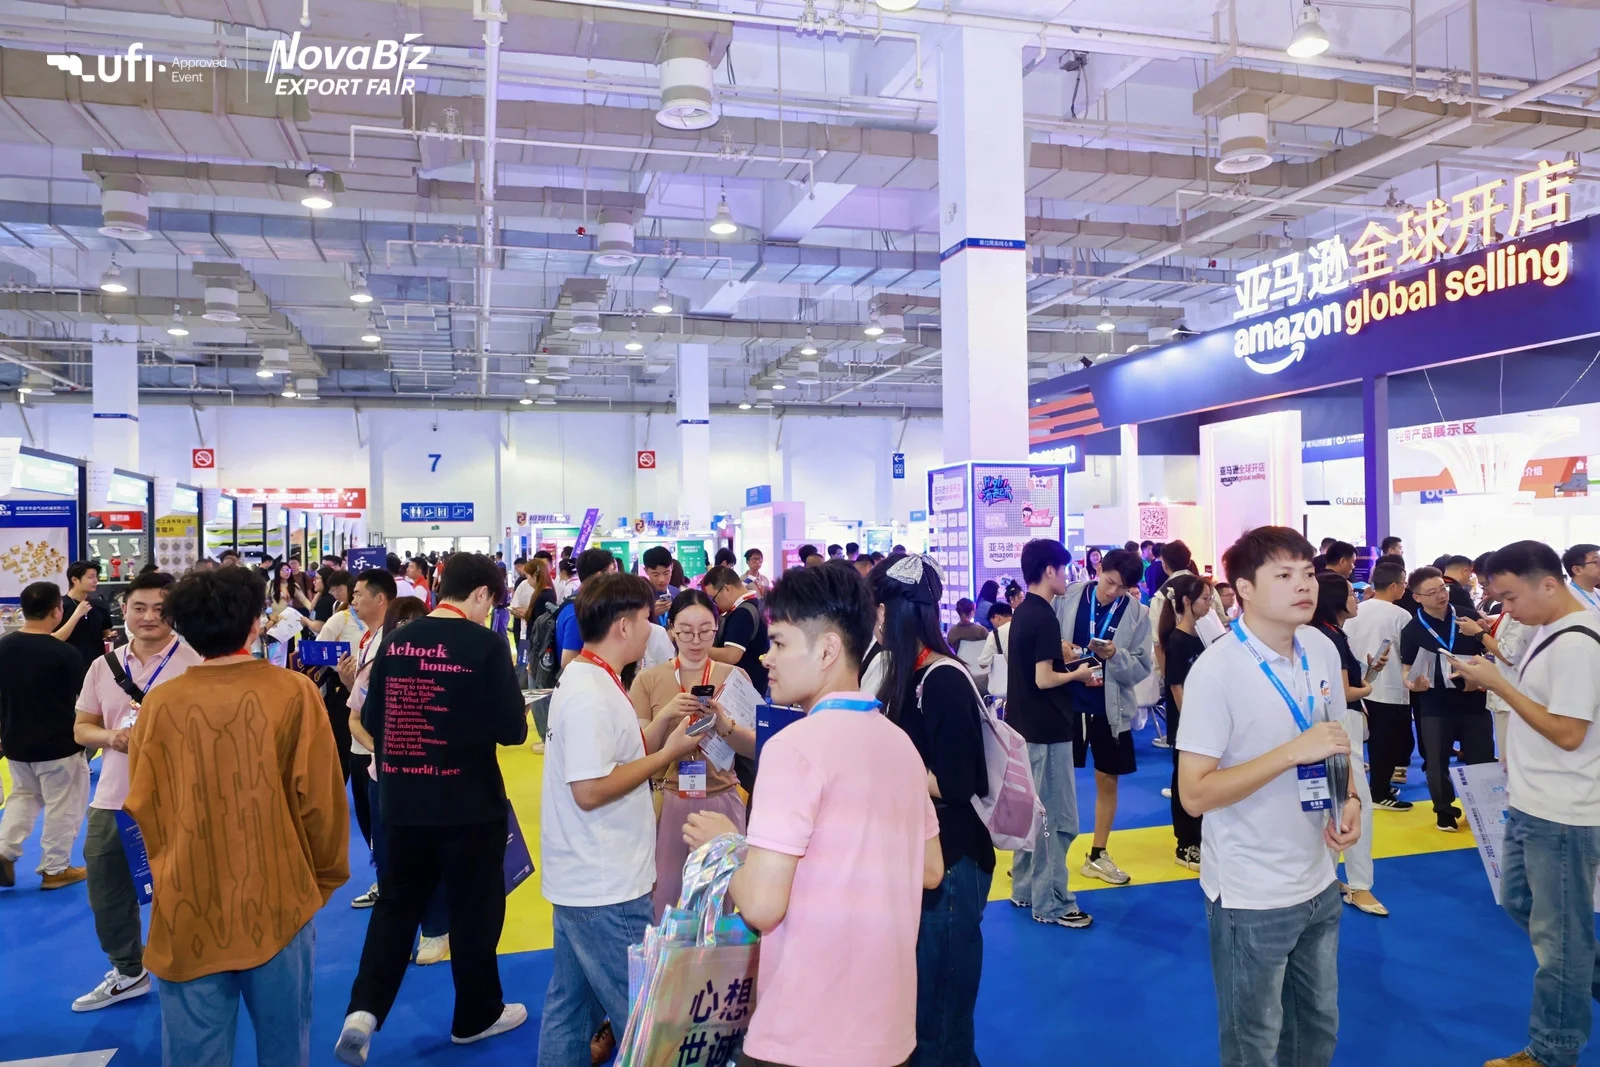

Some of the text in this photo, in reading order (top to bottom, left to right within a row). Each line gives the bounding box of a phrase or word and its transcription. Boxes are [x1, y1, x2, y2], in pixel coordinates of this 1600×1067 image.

[1233, 158, 1578, 322] 亚马逊全球开店
[1233, 239, 1571, 358] amazon global selling
[427, 454, 441, 473] 7
[1220, 463, 1266, 476] 亚马逊全球开店
[1220, 475, 1239, 483] amazon
[988, 542, 1025, 552] 亚马逊全
[386, 642, 448, 659] Achock
[402, 764, 433, 774] world
[689, 977, 754, 1024] 心想
